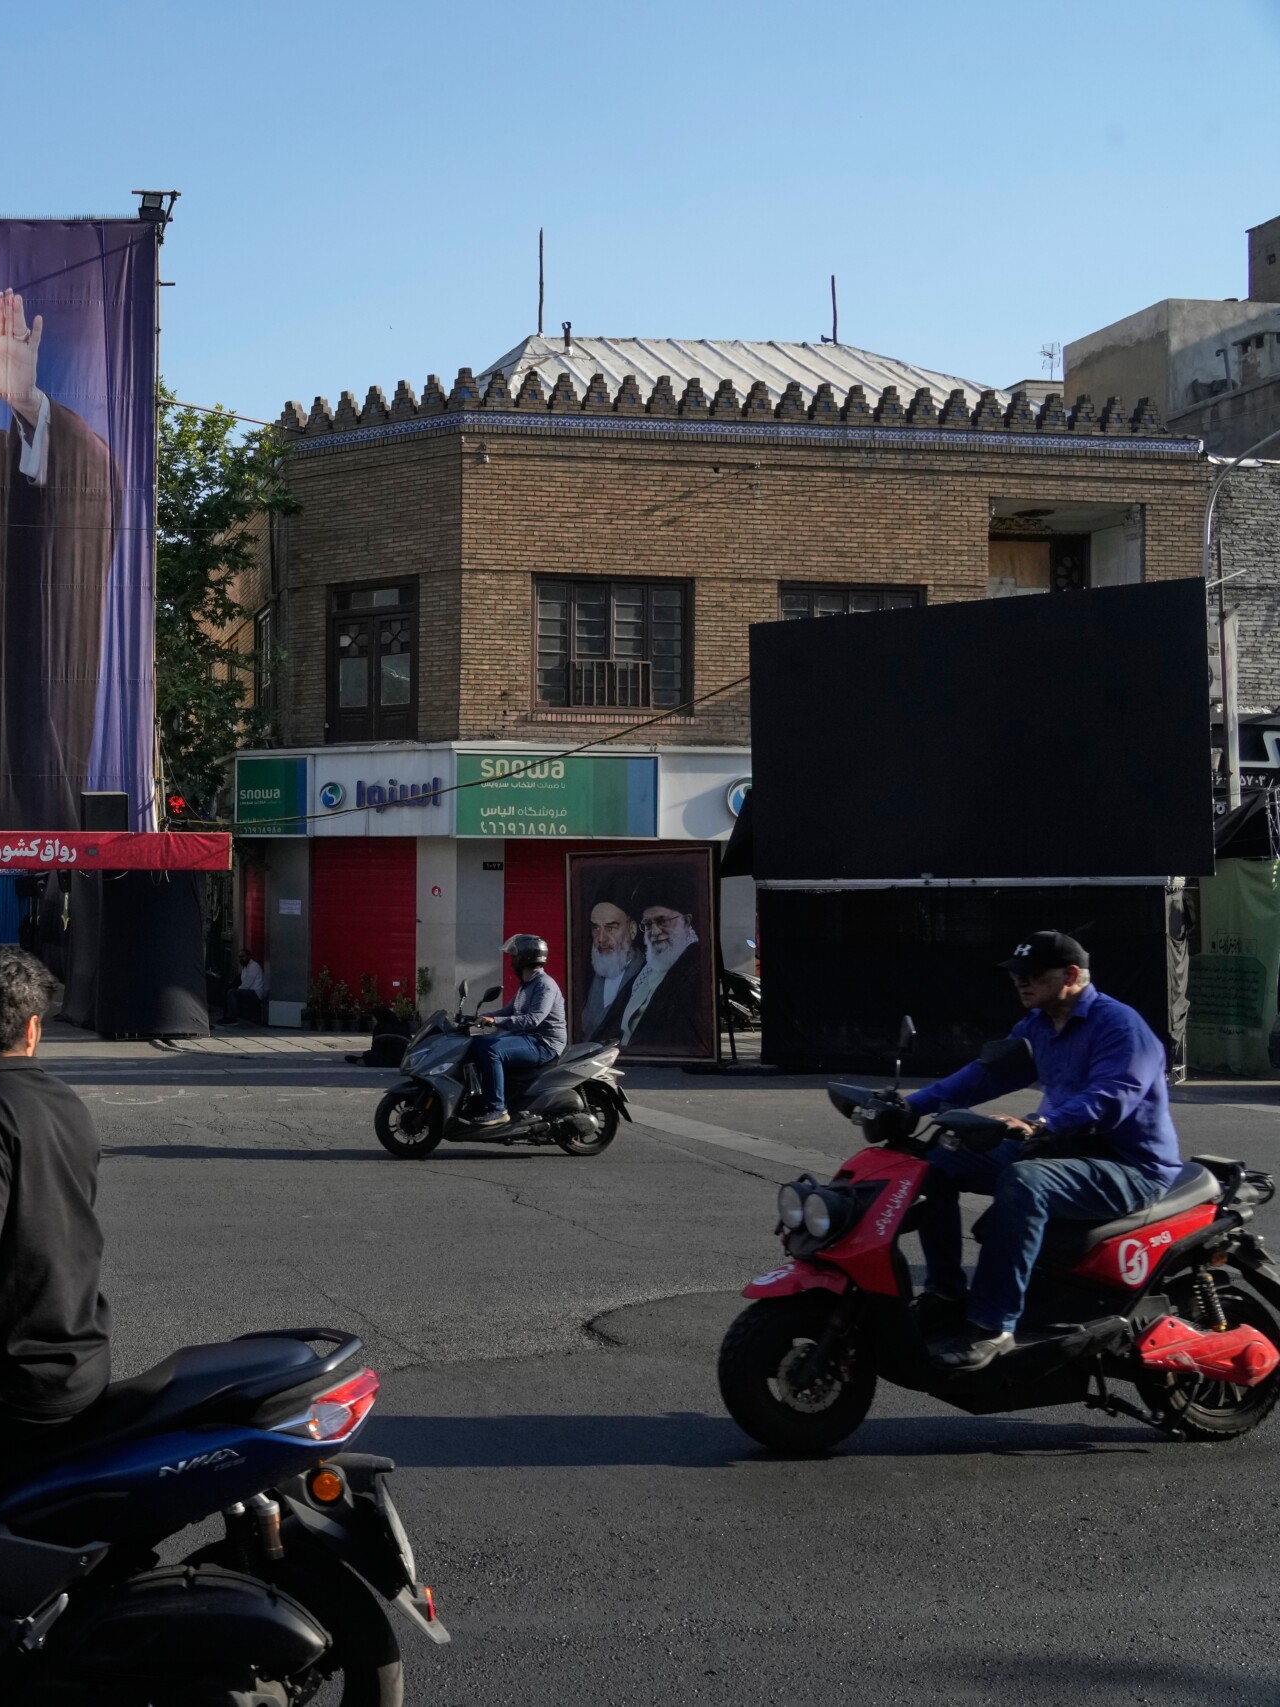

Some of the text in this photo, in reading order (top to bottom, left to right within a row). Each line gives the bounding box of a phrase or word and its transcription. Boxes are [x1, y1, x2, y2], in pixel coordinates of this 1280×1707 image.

[480, 758, 565, 778] snowa
[240, 788, 280, 800] snowa
[356, 777, 442, 814] اسنوا
[480, 806, 567, 818] فروشگاه الیاس
[40, 838, 76, 862] رواق
